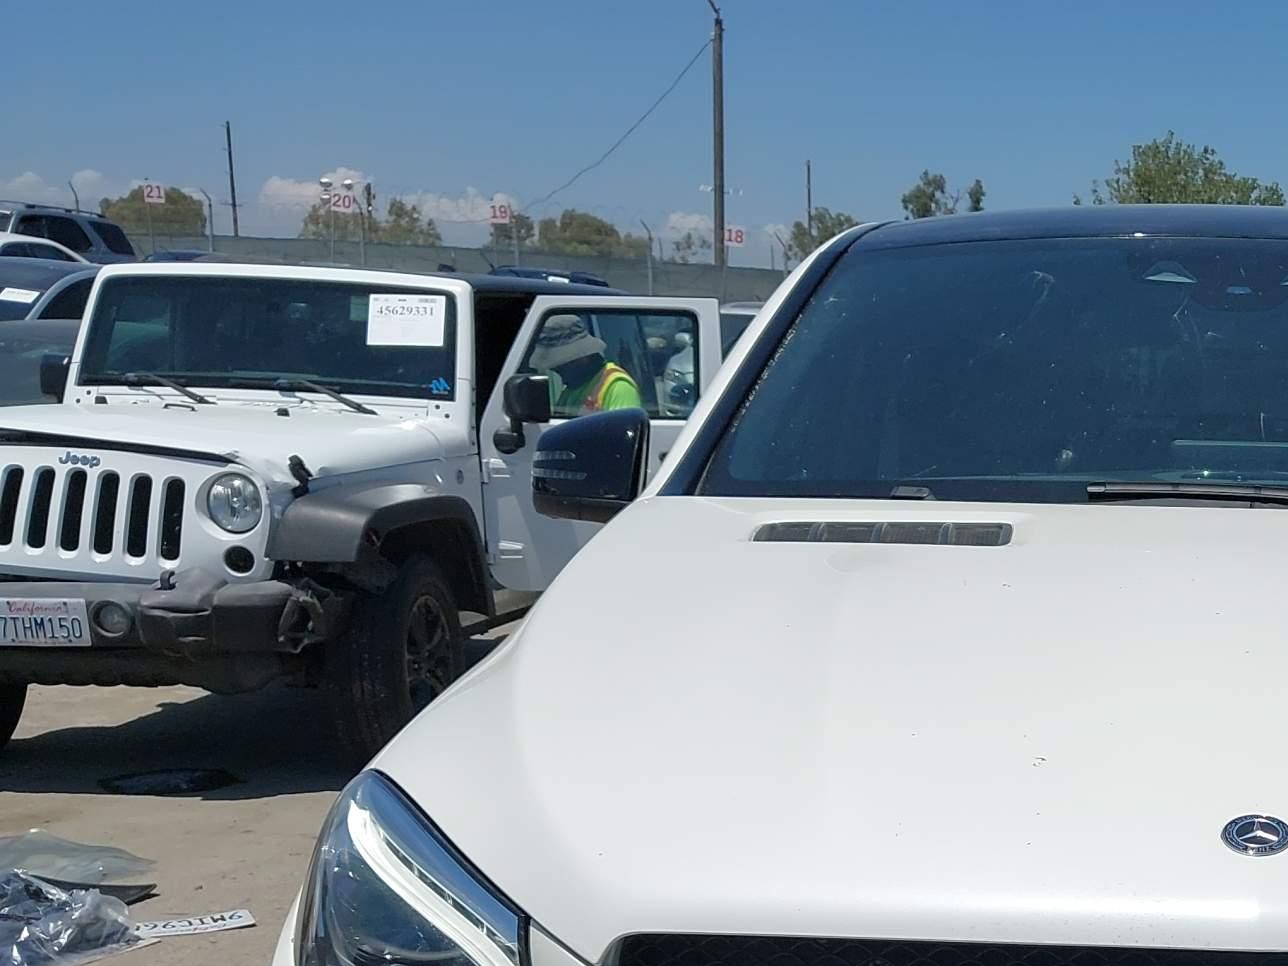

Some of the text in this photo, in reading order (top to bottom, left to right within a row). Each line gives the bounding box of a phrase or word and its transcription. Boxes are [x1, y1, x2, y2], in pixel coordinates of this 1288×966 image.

[145, 184, 164, 199] 21
[332, 193, 352, 209] 20
[490, 204, 508, 219] 19
[727, 228, 744, 244] 18
[376, 305, 434, 316] 45629331
[58, 451, 101, 469] Jeep
[0, 616, 83, 639] 7THM150
